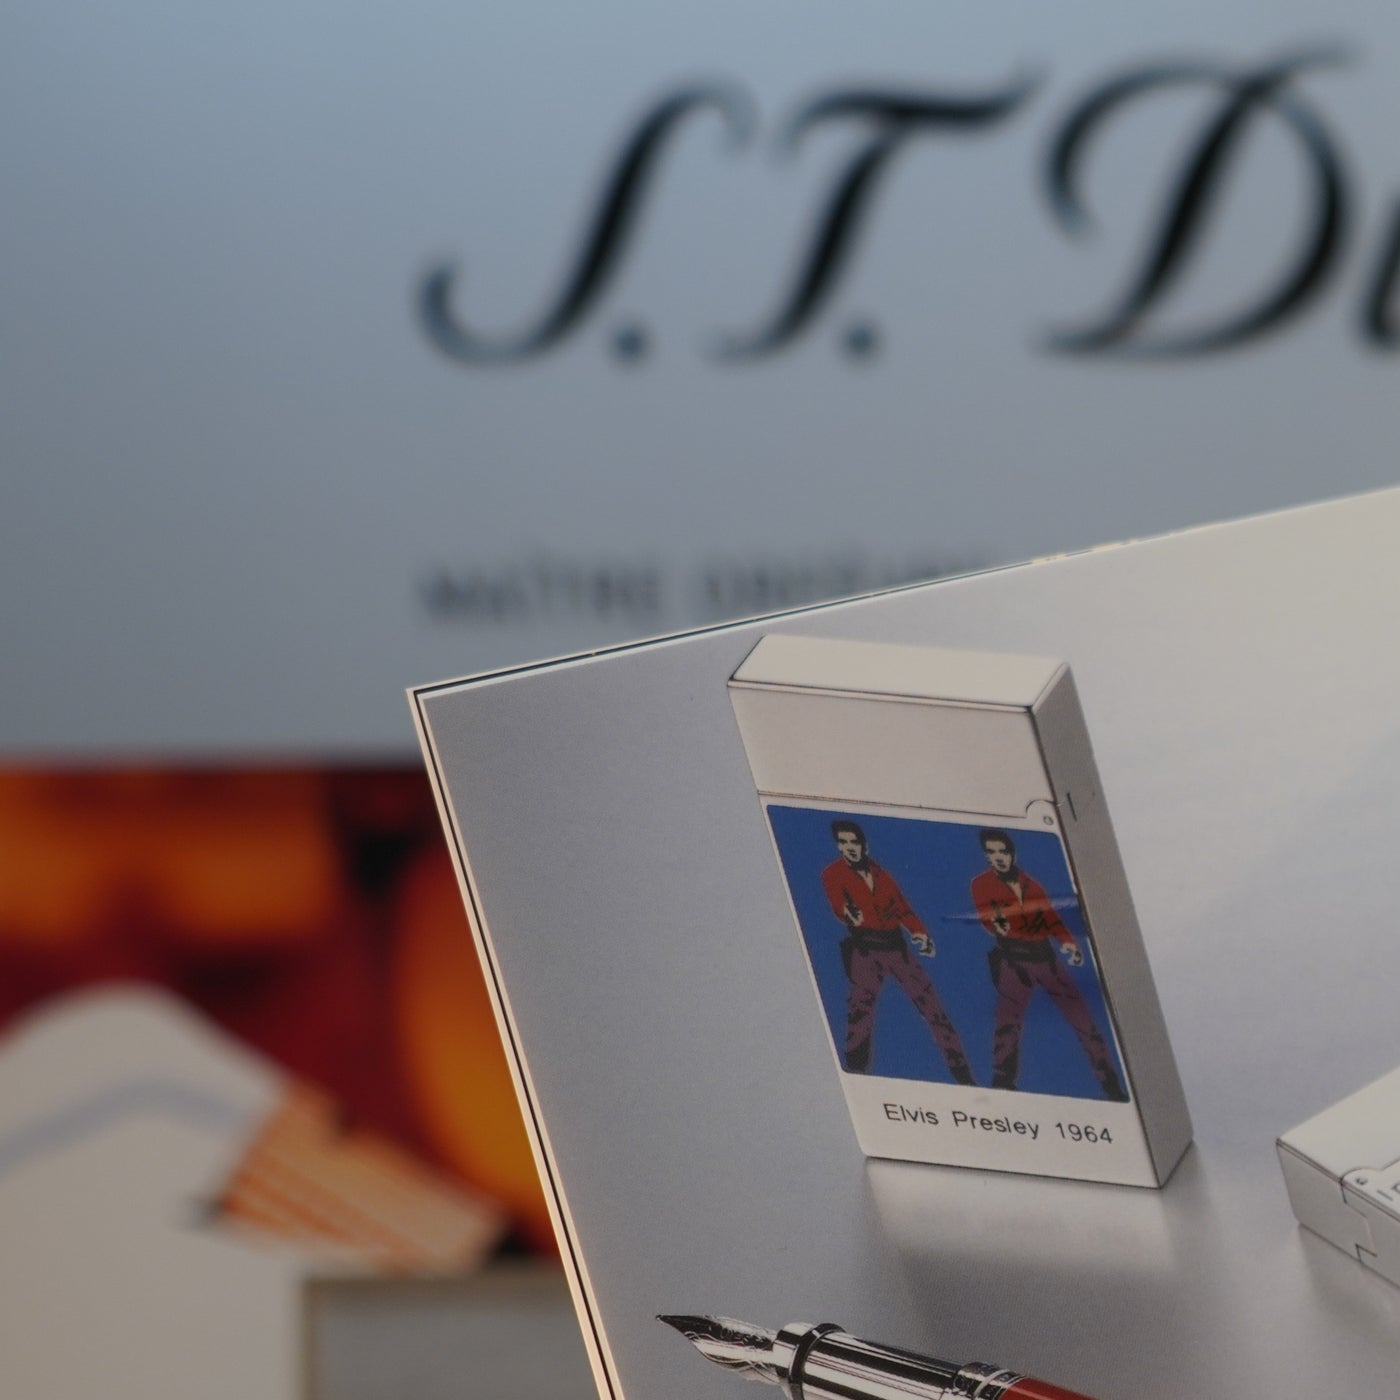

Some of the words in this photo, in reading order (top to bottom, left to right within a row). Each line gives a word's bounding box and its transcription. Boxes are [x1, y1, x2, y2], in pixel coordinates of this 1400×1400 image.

[882, 1102, 940, 1126] Elvis
[951, 1110, 1040, 1140] Presley
[1055, 1122, 1114, 1145] 1964
